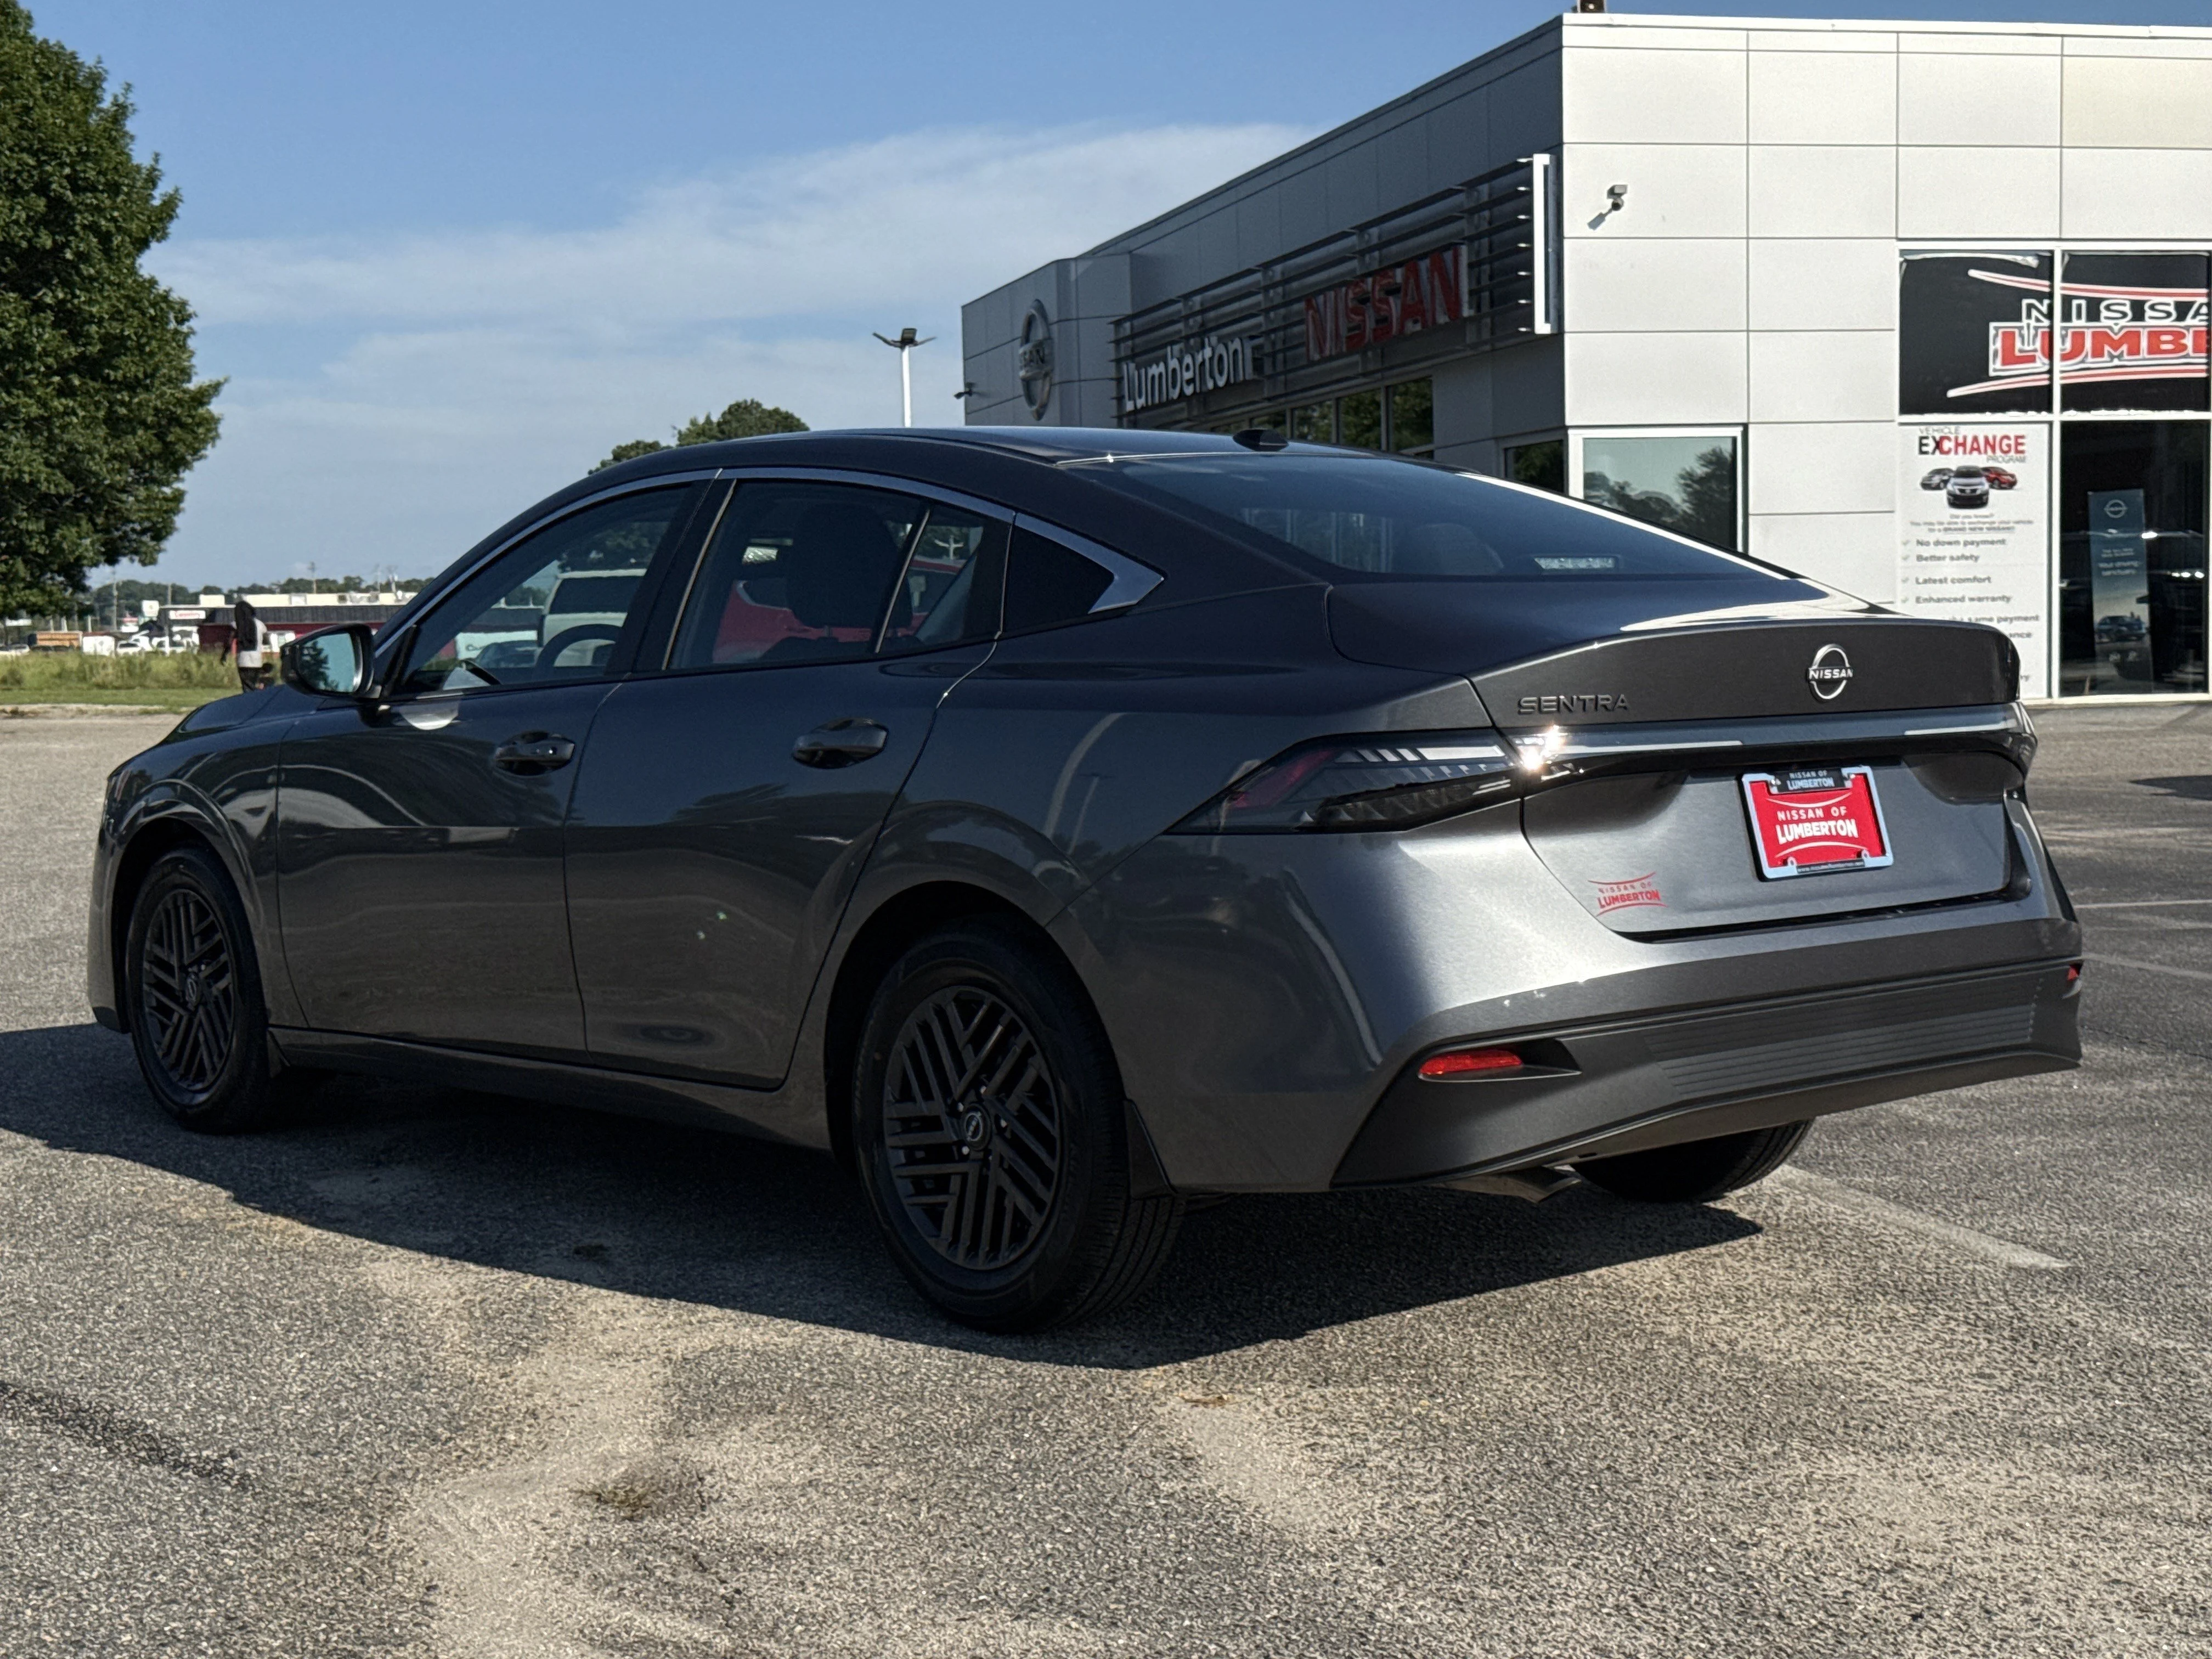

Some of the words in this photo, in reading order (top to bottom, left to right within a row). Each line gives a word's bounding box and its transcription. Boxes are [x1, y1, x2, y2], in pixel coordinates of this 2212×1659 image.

[1305, 246, 1465, 361] NISSAN
[1124, 337, 1246, 413] Lumberton
[1918, 434, 2026, 455] EXCHANGE
[1987, 455, 2026, 464] PROGRAM
[1933, 538, 1961, 546] down
[1963, 539, 2006, 548] payment
[1916, 554, 1947, 562] Better
[1949, 553, 1980, 563] safety
[1915, 576, 1948, 585] Latest
[1950, 575, 1992, 584] comfort
[1915, 594, 1966, 603] Enhanced
[1967, 594, 2011, 603] warranty
[1996, 614, 2040, 624] payment
[1809, 668, 1853, 680] NISSAN
[1518, 694, 1631, 715] SENTRA
[1788, 771, 1817, 779] NISSAN
[1786, 776, 1835, 791] LUMBERTON
[1776, 808, 1824, 822] NISSAN
[1830, 805, 1847, 817] OF
[1775, 818, 1859, 845] LUMBERTON
[1598, 884, 1636, 894] NISSAN
[1640, 881, 1652, 889] OF
[1596, 889, 1661, 909] LUMBERTON
